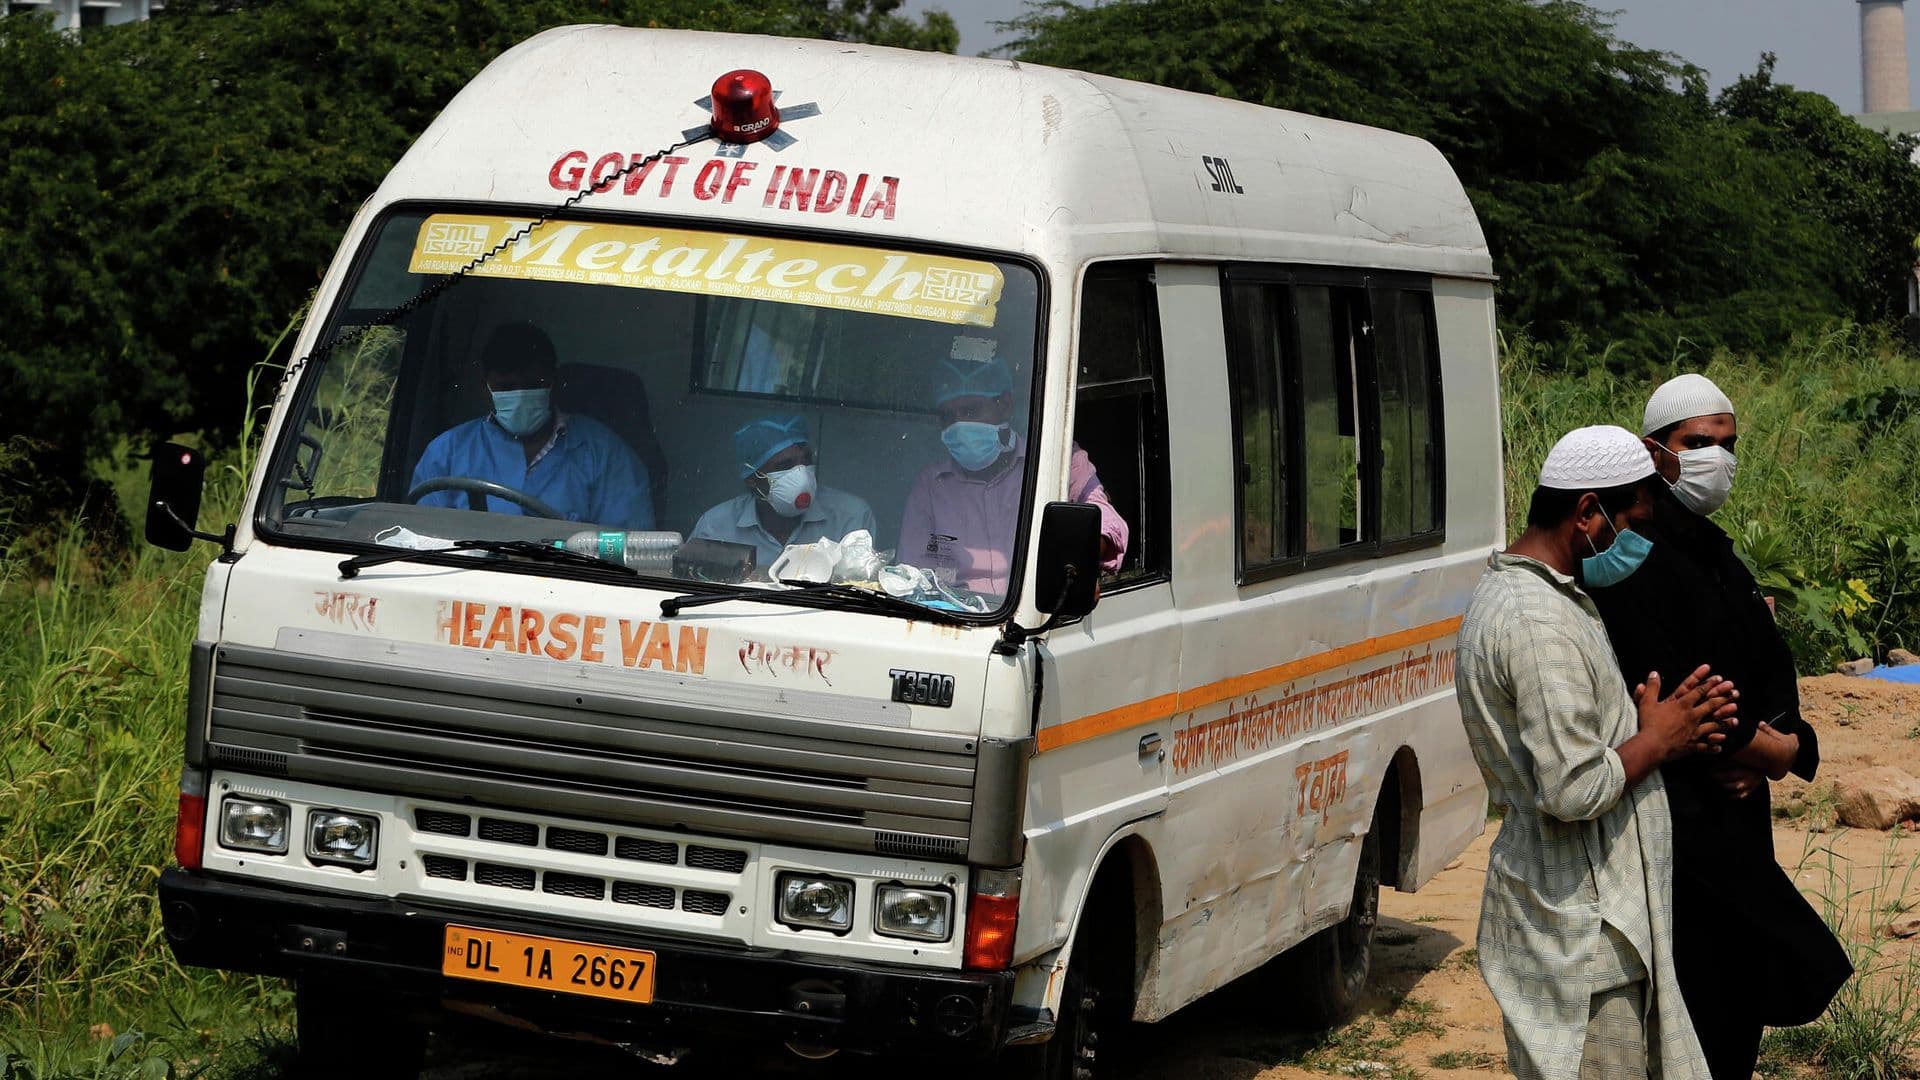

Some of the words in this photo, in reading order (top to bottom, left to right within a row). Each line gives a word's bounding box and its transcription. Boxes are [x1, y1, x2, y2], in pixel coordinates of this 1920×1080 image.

[741, 117, 770, 132] GRAND
[548, 150, 690, 200] GOVT
[693, 159, 758, 205] OF
[762, 164, 901, 220] INDIA
[1202, 155, 1245, 195] SML
[424, 239, 485, 256] ISUZU
[428, 223, 489, 241] SML
[494, 219, 926, 301] Metaltech
[926, 268, 993, 291] SML
[434, 599, 608, 665] HEARSE
[617, 617, 710, 676] VAN
[889, 669, 955, 707] T3500
[447, 946, 464, 957] IND
[465, 937, 500, 973] DL
[523, 946, 553, 981] 1A
[570, 953, 646, 991] 2667
